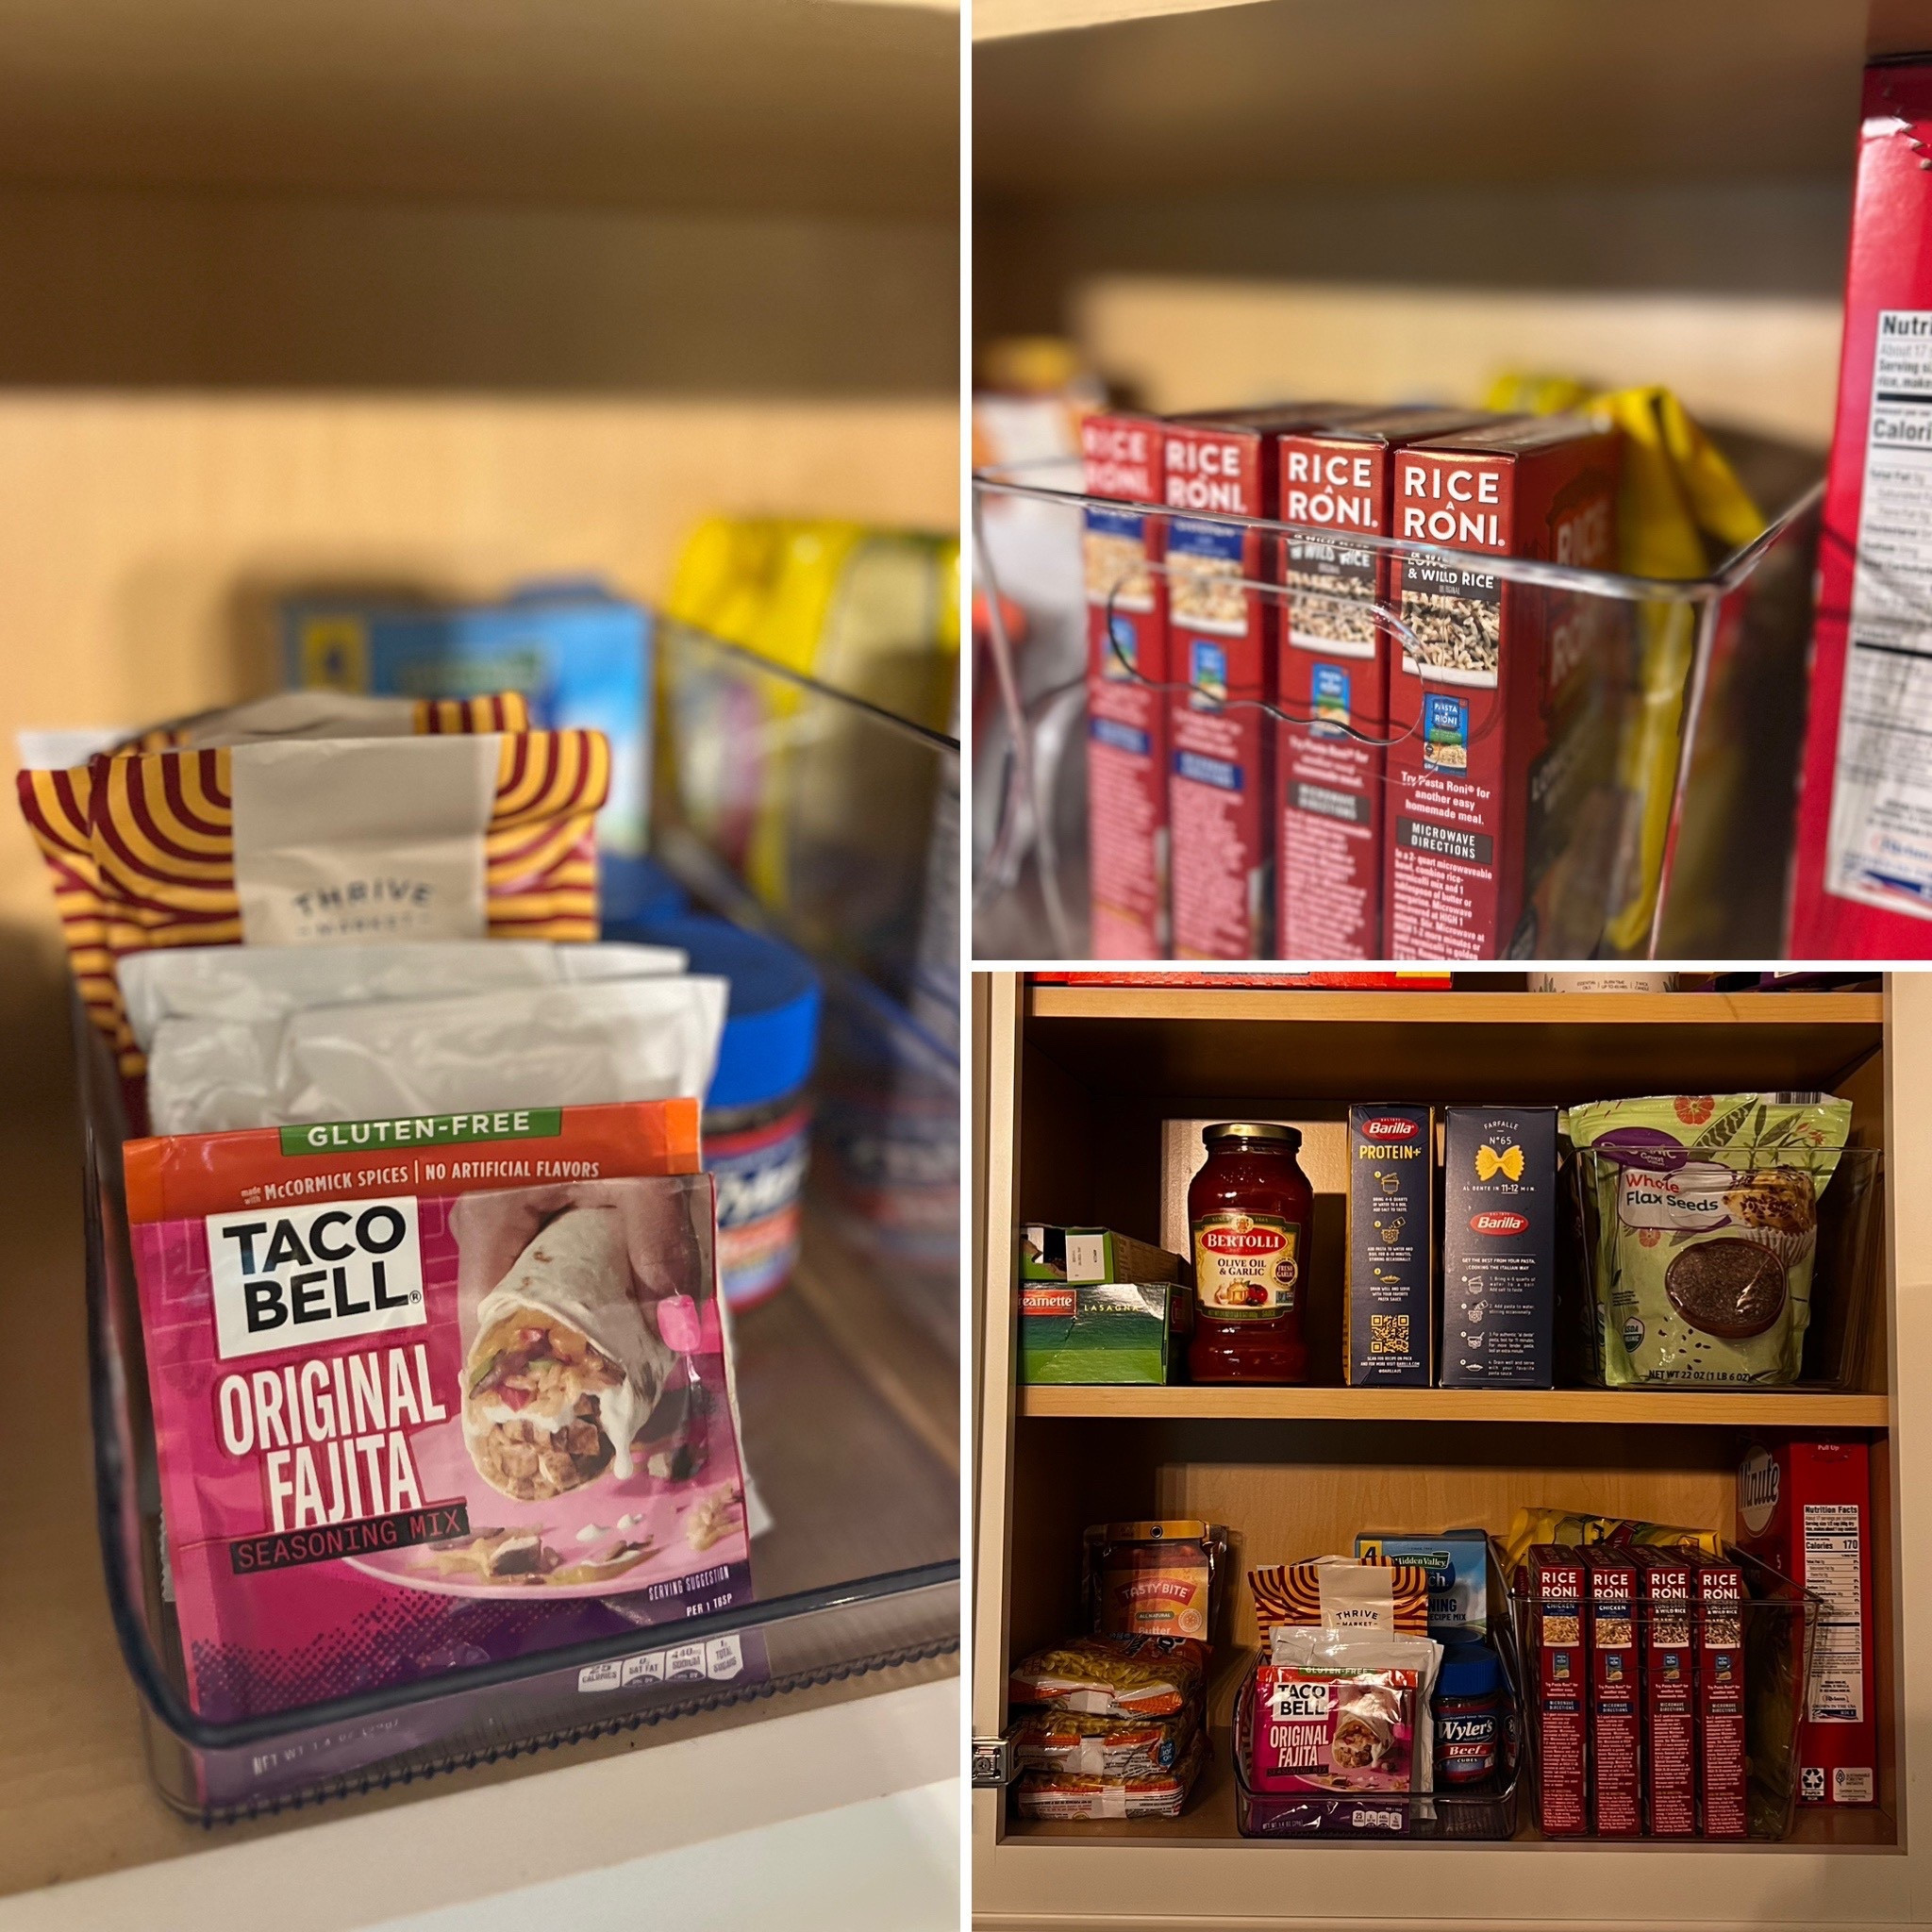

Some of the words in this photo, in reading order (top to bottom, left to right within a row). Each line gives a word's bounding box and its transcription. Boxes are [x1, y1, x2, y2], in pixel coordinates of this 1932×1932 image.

[1166, 441, 1241, 476] RICE
[1289, 452, 1372, 488] RICE
[1405, 466, 1499, 504] RICE
[1461, 573, 1494, 590] RICE
[1401, 771, 1417, 787] Try
[1419, 774, 1444, 791] Pasta
[1476, 787, 1490, 799] for
[1415, 790, 1451, 805] another
[1453, 798, 1475, 811] easy
[1406, 799, 1456, 819] homemade
[1458, 811, 1484, 824] meal.
[1412, 823, 1475, 846] MICROWAVE
[1411, 835, 1475, 858] DIRECTIONS
[1418, 856, 1436, 867] quart
[1437, 859, 1492, 879] microwaveable
[295, 877, 431, 914] THRIVE
[1445, 883, 1458, 893] and
[1442, 891, 1462, 905] butter
[1432, 900, 1472, 918] Microwave
[1440, 912, 1457, 924] HIGH
[1436, 922, 1475, 940] Microwave
[308, 1111, 530, 1147] GLUTEN-FREE
[1369, 1122, 1412, 1134] Barilla
[1484, 1121, 1519, 1130] FARFALLE
[1359, 1145, 1422, 1159] PROTEIN+
[264, 1172, 352, 1200] McCORMICK
[358, 1166, 408, 1187] SPICES
[425, 1162, 446, 1181] NO
[452, 1160, 530, 1179] ARTIFICIAL
[537, 1160, 599, 1177] FLAVORS
[1501, 1184, 1518, 1192] 11-12
[1626, 1174, 1679, 1193] Whole
[241, 1186, 261, 1198] made
[245, 1195, 261, 1206] with
[1626, 1191, 1662, 1206] Flax
[1667, 1195, 1719, 1211] Seeds
[1478, 1217, 1521, 1228] Barilla
[223, 1206, 406, 1275] TACO
[1208, 1234, 1279, 1248] BERTOLLI
[1218, 1258, 1246, 1268] OLIVE
[1249, 1258, 1267, 1268] OIL
[1219, 1267, 1226, 1275] &
[1228, 1267, 1265, 1276] GARLIC
[1085, 1304, 1138, 1312] LASAGNA
[1649, 1370, 1665, 1379] NET
[220, 1344, 446, 1456] ORIGINAL
[266, 1430, 423, 1533] FAJITA
[237, 1521, 396, 1568] SEASONING
[409, 1513, 460, 1540] MIX
[1843, 1540, 1857, 1549] 170
[1424, 1557, 1446, 1567] Valley
[649, 1580, 683, 1601] SERVING
[686, 1565, 729, 1592] SUGGESTION
[1541, 1573, 1576, 1583] RICE
[1594, 1574, 1628, 1585] RICE
[1652, 1574, 1686, 1584] RICE
[1704, 1574, 1737, 1585] RICE
[1122, 1583, 1160, 1599] TASTY
[1162, 1583, 1189, 1598] BITE
[687, 1601, 703, 1616] PER
[713, 1593, 732, 1608] TBSP
[1336, 1610, 1378, 1620] THRIVE
[1139, 1626, 1171, 1635] Butter
[1277, 1684, 1325, 1699] TACO
[1280, 1700, 1325, 1716] BELL
[1270, 1725, 1328, 1748] ORIGINAL
[1439, 1720, 1492, 1741] Wyler's
[1278, 1745, 1319, 1768] FAJITA
[1450, 1746, 1482, 1756] Beef
